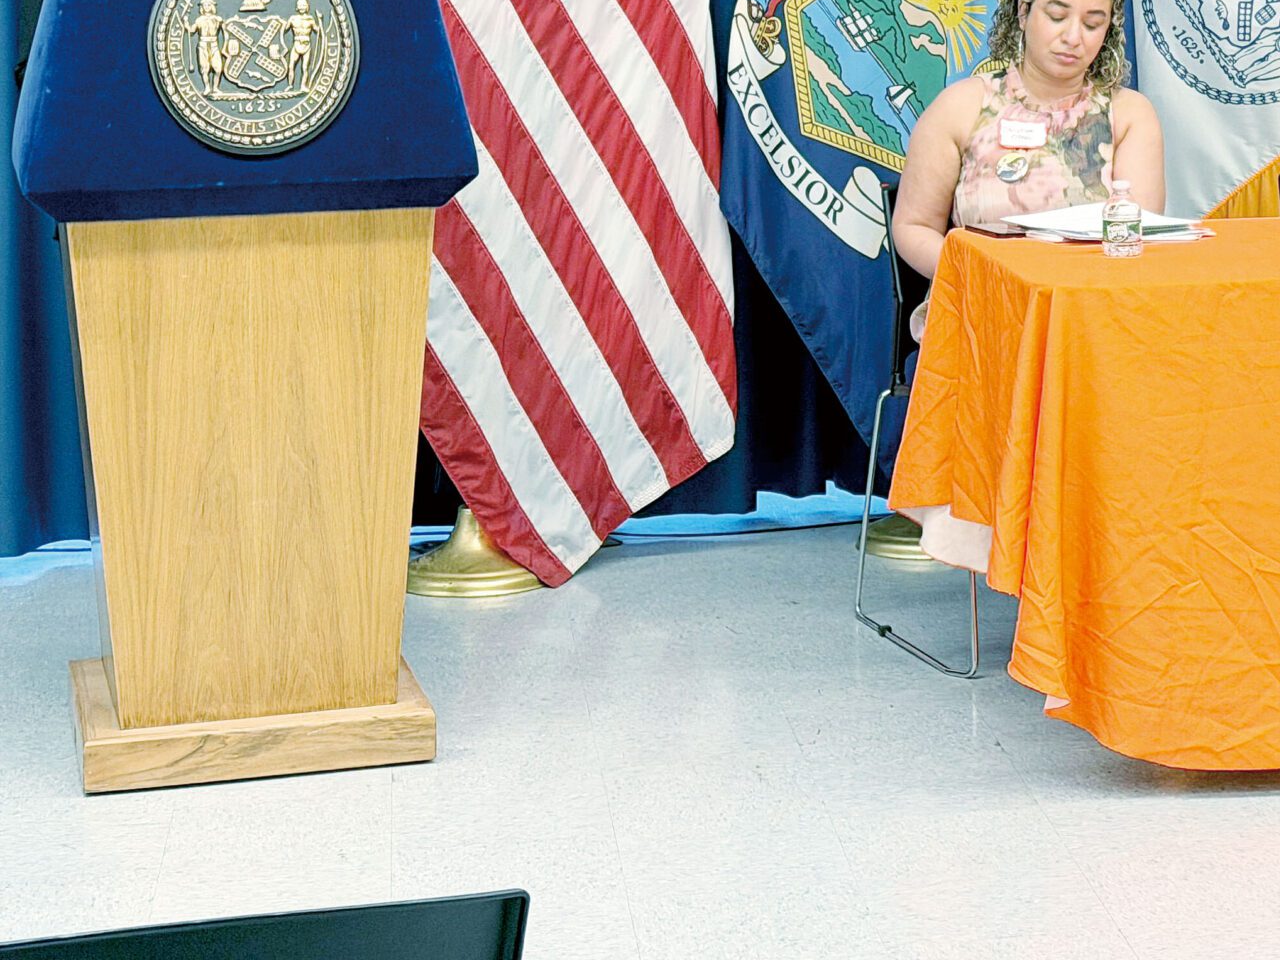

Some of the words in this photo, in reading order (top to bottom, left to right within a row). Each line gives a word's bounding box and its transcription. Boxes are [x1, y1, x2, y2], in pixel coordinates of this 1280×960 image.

[1174, 29, 1206, 59] 1625
[169, 27, 193, 101] SIGILLUM
[196, 102, 266, 134] CIVITATIS
[276, 104, 311, 129] NOVI
[315, 40, 338, 102] EBORACI
[238, 101, 276, 114] 1625
[728, 59, 845, 226] EXCELSIOR
